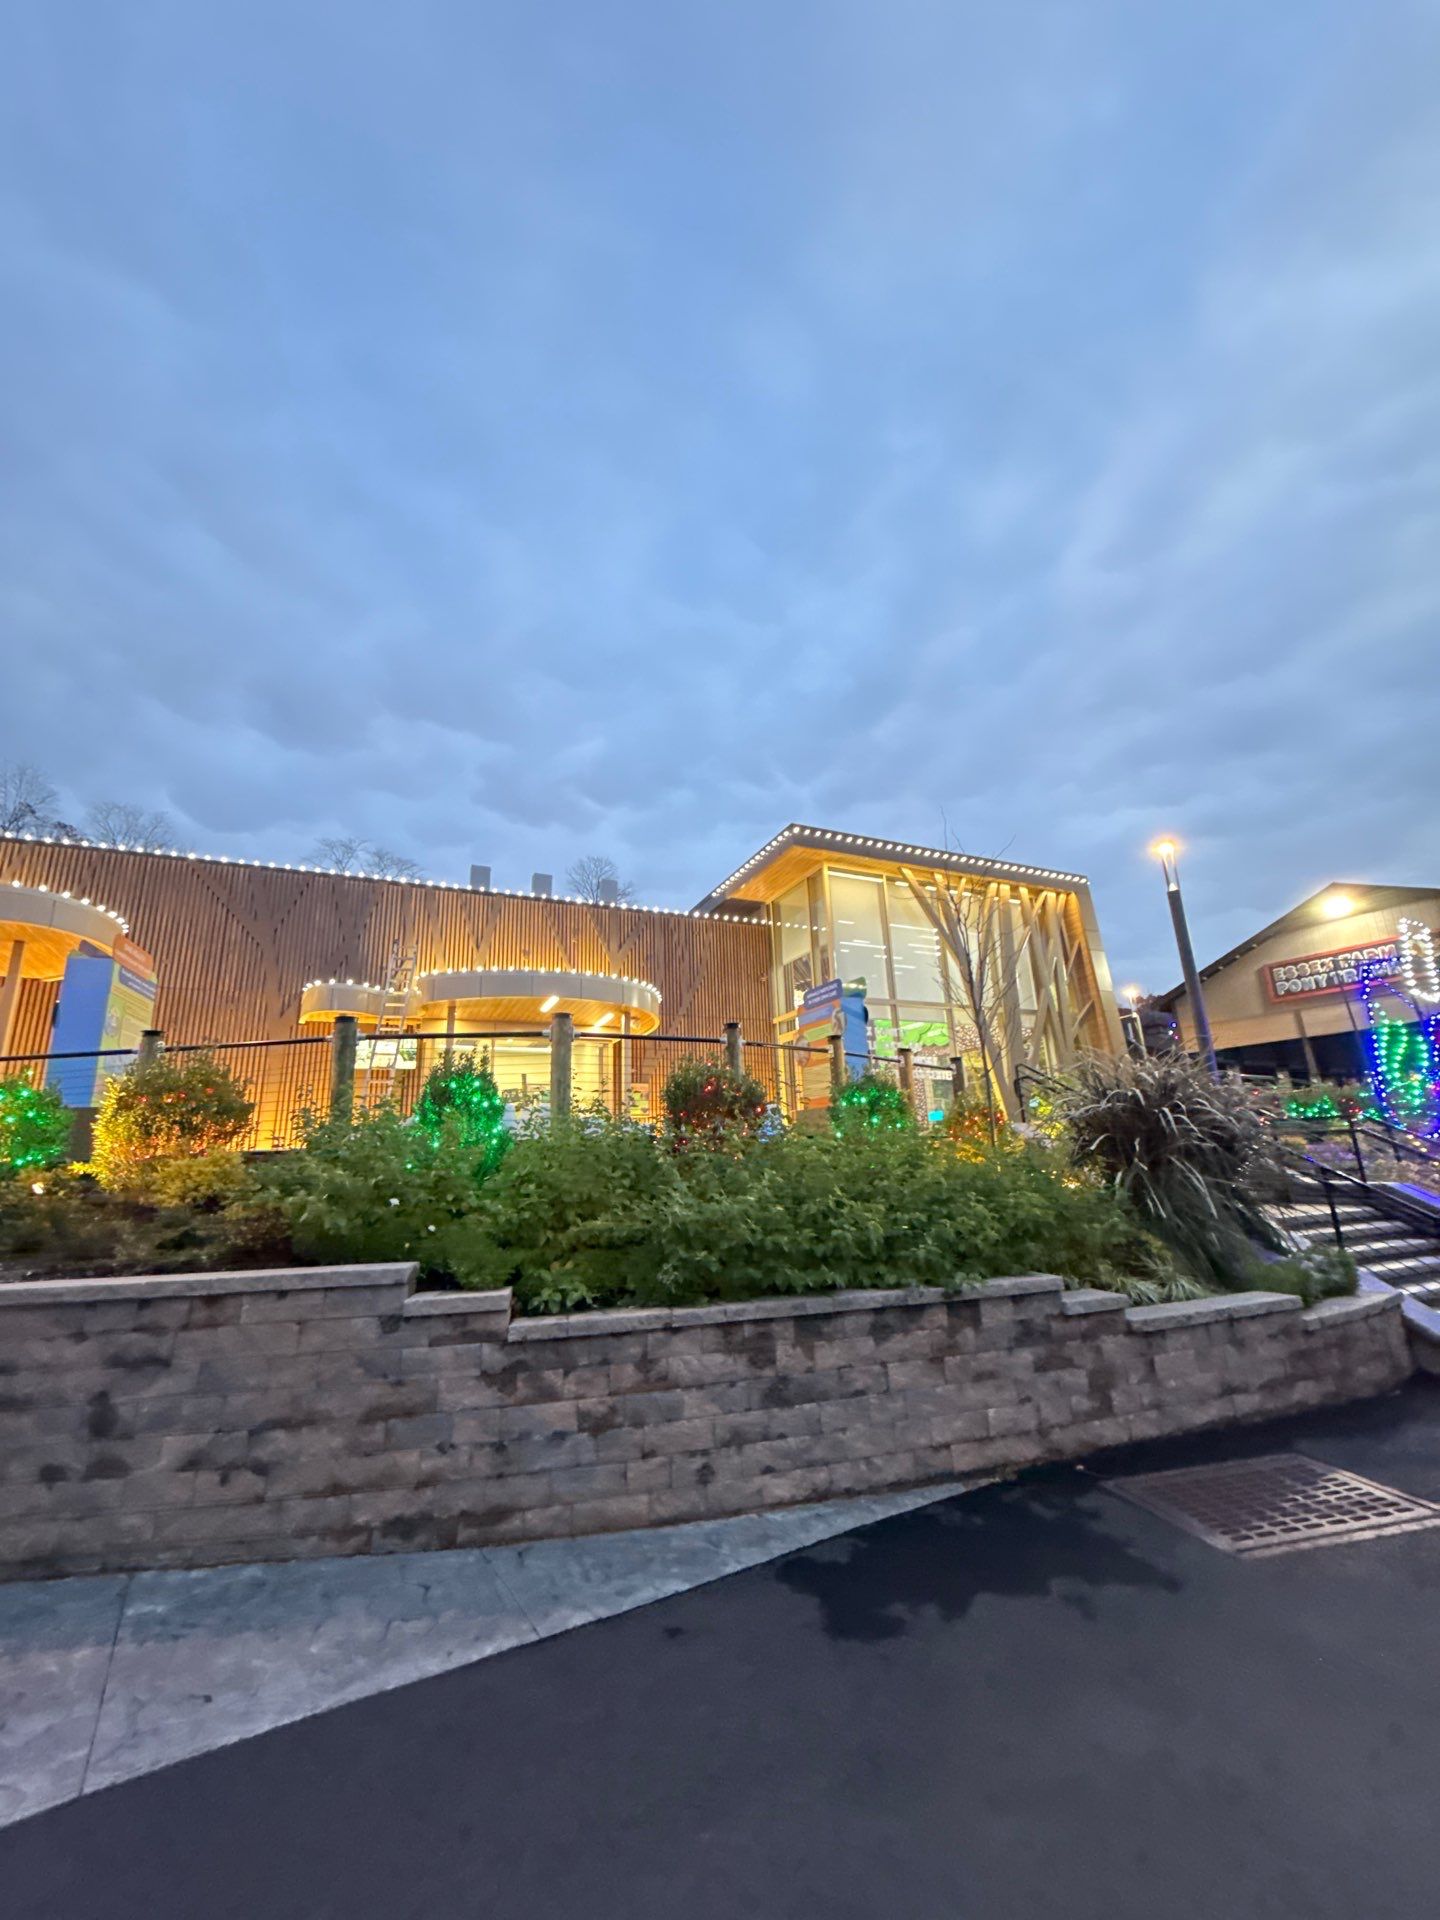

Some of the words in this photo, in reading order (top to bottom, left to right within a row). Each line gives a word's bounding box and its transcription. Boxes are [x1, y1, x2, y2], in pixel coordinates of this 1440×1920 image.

[1272, 957, 1334, 982] ESSEX
[1338, 943, 1398, 968] FARM
[1275, 973, 1328, 996] PONY
